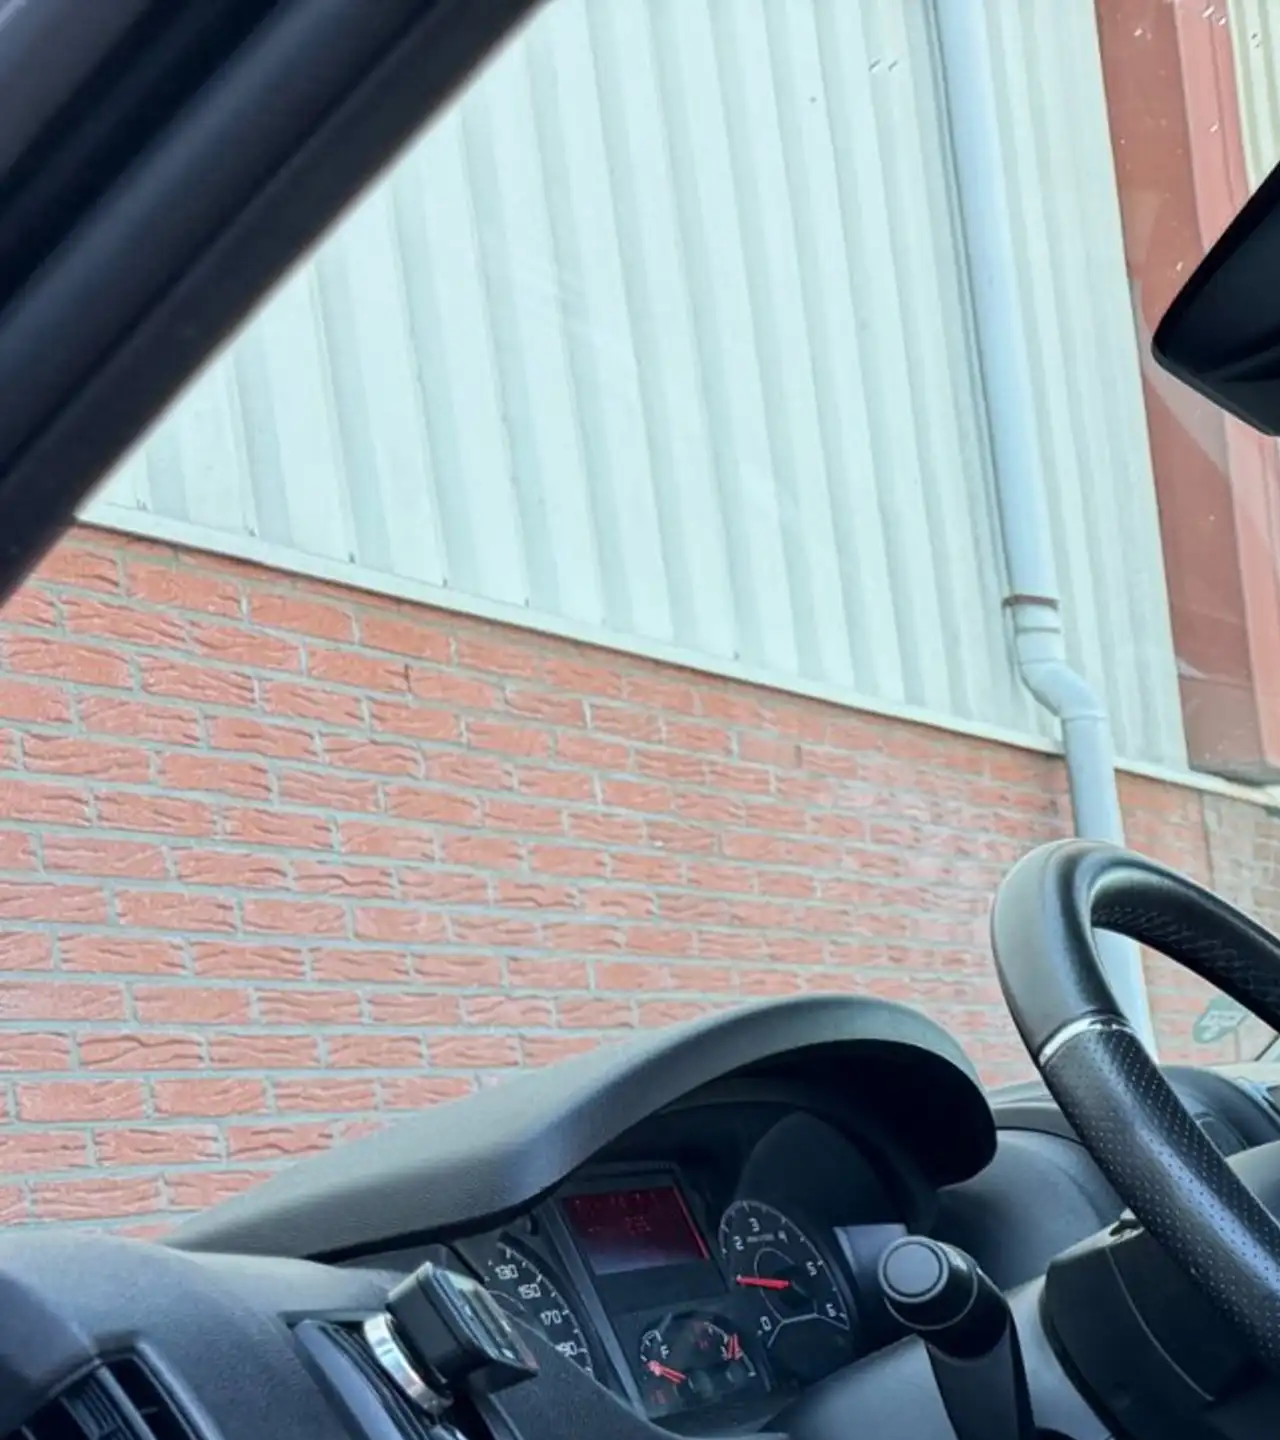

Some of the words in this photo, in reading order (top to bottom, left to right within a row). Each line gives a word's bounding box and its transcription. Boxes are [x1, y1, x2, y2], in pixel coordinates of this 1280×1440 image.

[748, 1217, 760, 1232] 3
[733, 1235, 745, 1250] 2
[494, 1264, 519, 1280] 130
[805, 1261, 818, 1277] 5
[518, 1283, 541, 1299] 150
[540, 1310, 562, 1326] 170
[825, 1303, 837, 1318] 6
[759, 1315, 772, 1331] 0
